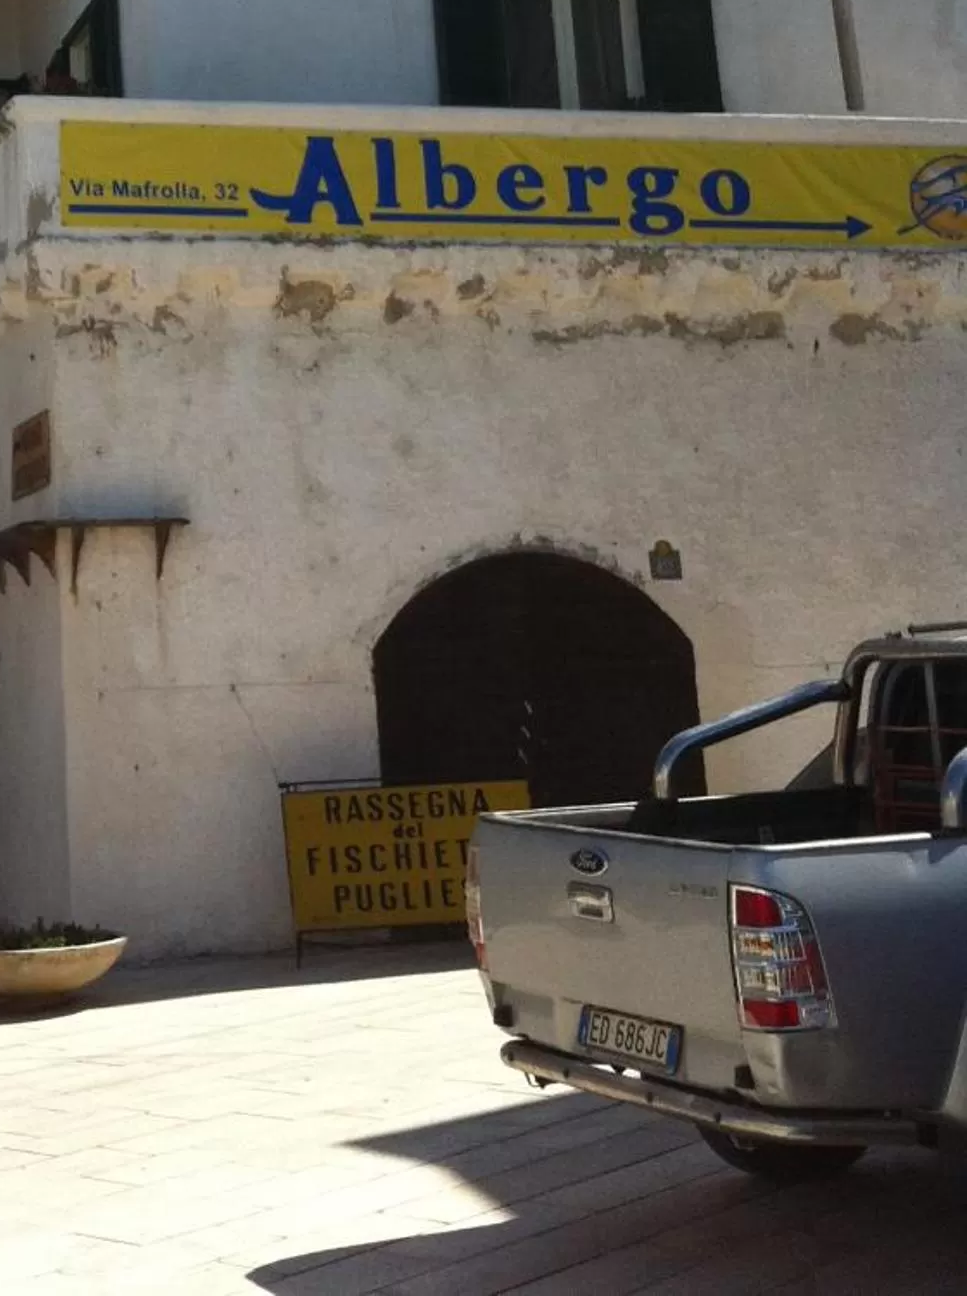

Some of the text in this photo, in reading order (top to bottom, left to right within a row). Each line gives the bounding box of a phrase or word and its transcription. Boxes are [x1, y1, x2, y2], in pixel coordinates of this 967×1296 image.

[69, 179, 104, 196] Via
[213, 182, 240, 201] 32
[250, 135, 752, 235] Albergo
[323, 788, 490, 824] RASSEGNA
[333, 878, 467, 914] PUGLIE
[589, 1013, 611, 1045] ED
